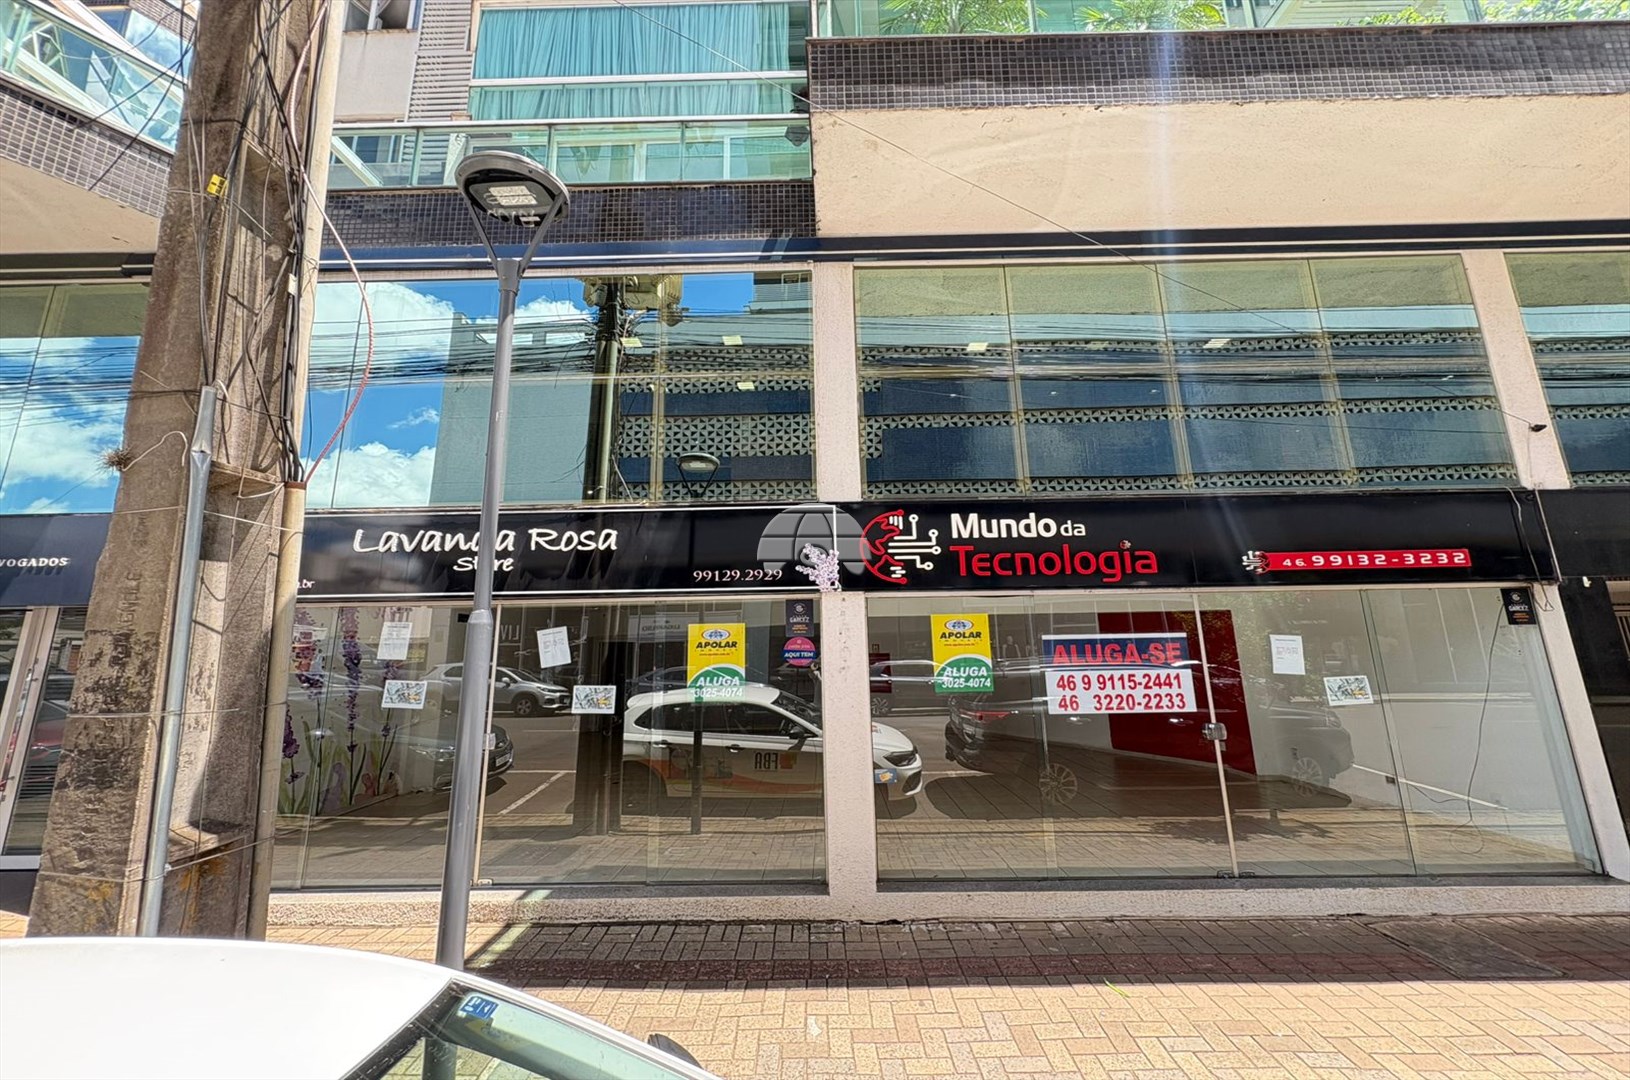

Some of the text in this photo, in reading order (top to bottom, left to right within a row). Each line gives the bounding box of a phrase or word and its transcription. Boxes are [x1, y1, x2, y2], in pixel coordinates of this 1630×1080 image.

[951, 512, 1086, 538] Mundo da
[528, 528, 618, 551] Rosa
[453, 555, 514, 571] Stre
[949, 540, 1158, 582] Tecnologia
[1311, 552, 1467, 566] 99132-3232
[693, 568, 783, 582] 99129.2929
[696, 641, 738, 649] APOLAR
[1052, 642, 1182, 664] ALUGA-SE
[943, 666, 988, 677] ALUGA
[695, 676, 740, 687] ALUGA
[941, 677, 992, 688] 3025-4074
[1056, 672, 1183, 691] 46 9 9115-2441
[1058, 692, 1187, 711] 46 3220-2233
